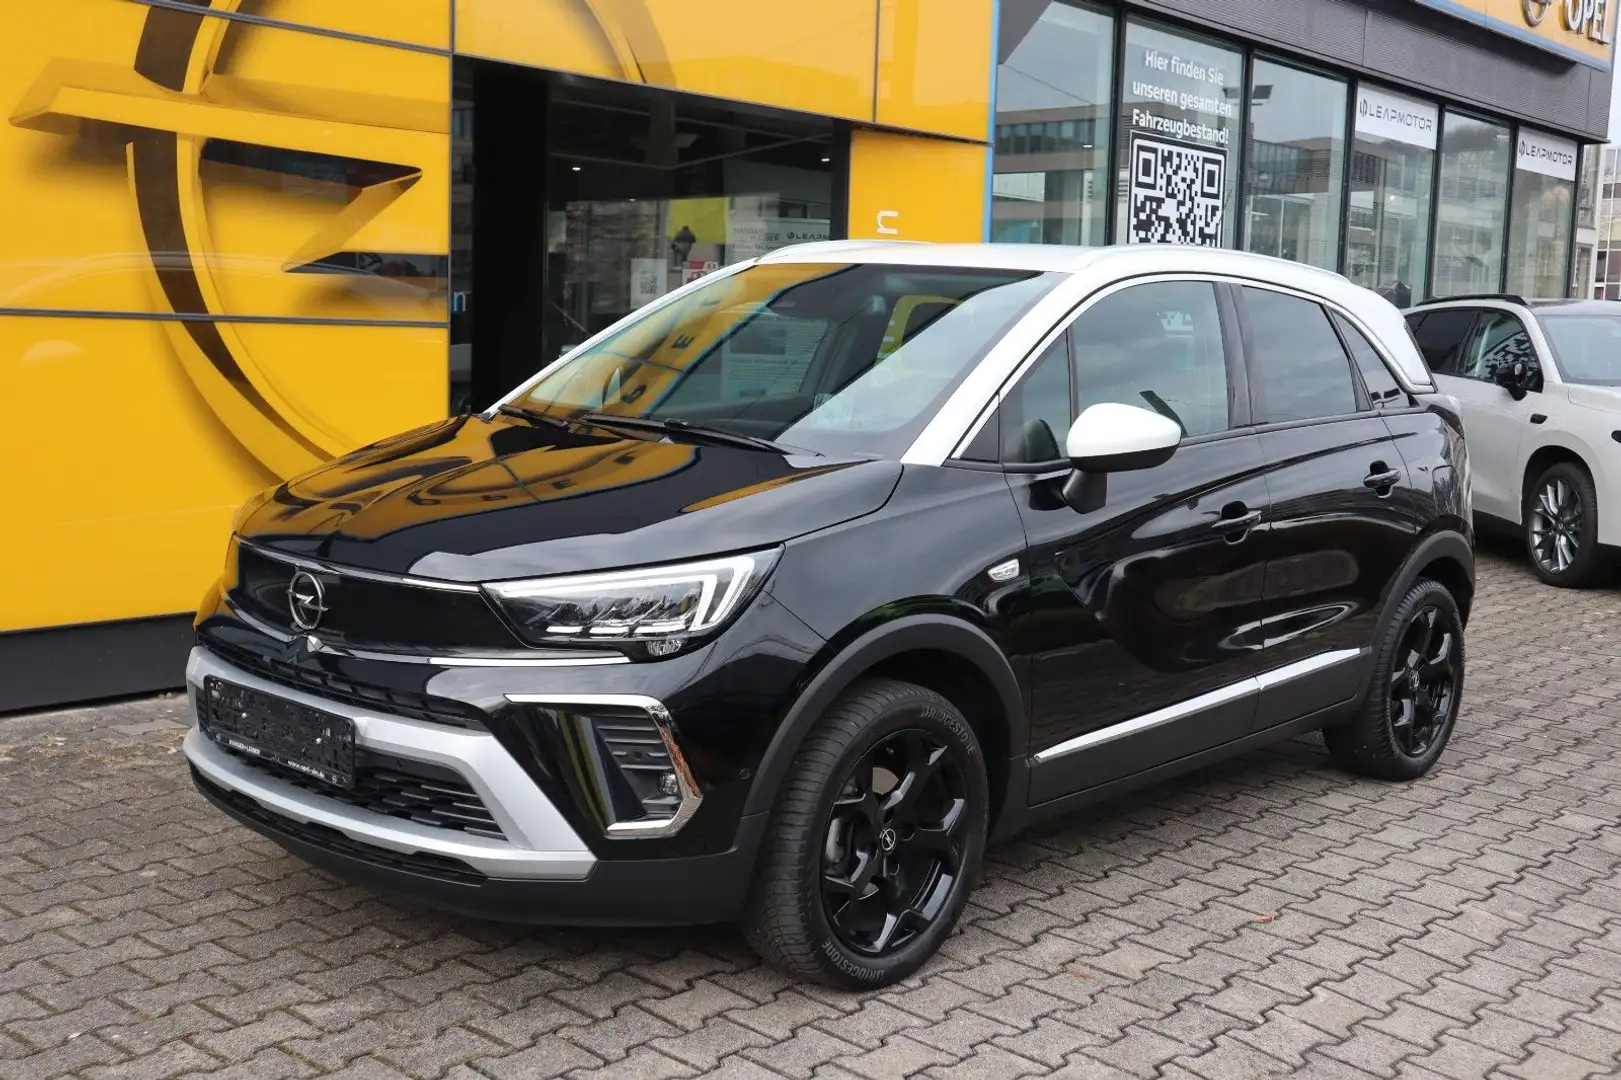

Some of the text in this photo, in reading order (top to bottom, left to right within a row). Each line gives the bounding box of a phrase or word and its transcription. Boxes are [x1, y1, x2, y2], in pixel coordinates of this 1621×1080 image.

[1564, 0, 1611, 43] OPEL
[1145, 49, 1224, 86] Hier finden Sie
[1132, 80, 1232, 117] unseren gesamten
[1132, 108, 1229, 145] Fahrzeugbestand!
[1369, 105, 1432, 132] LEAPMOTOR
[1525, 144, 1573, 166] LEAPMOTOR
